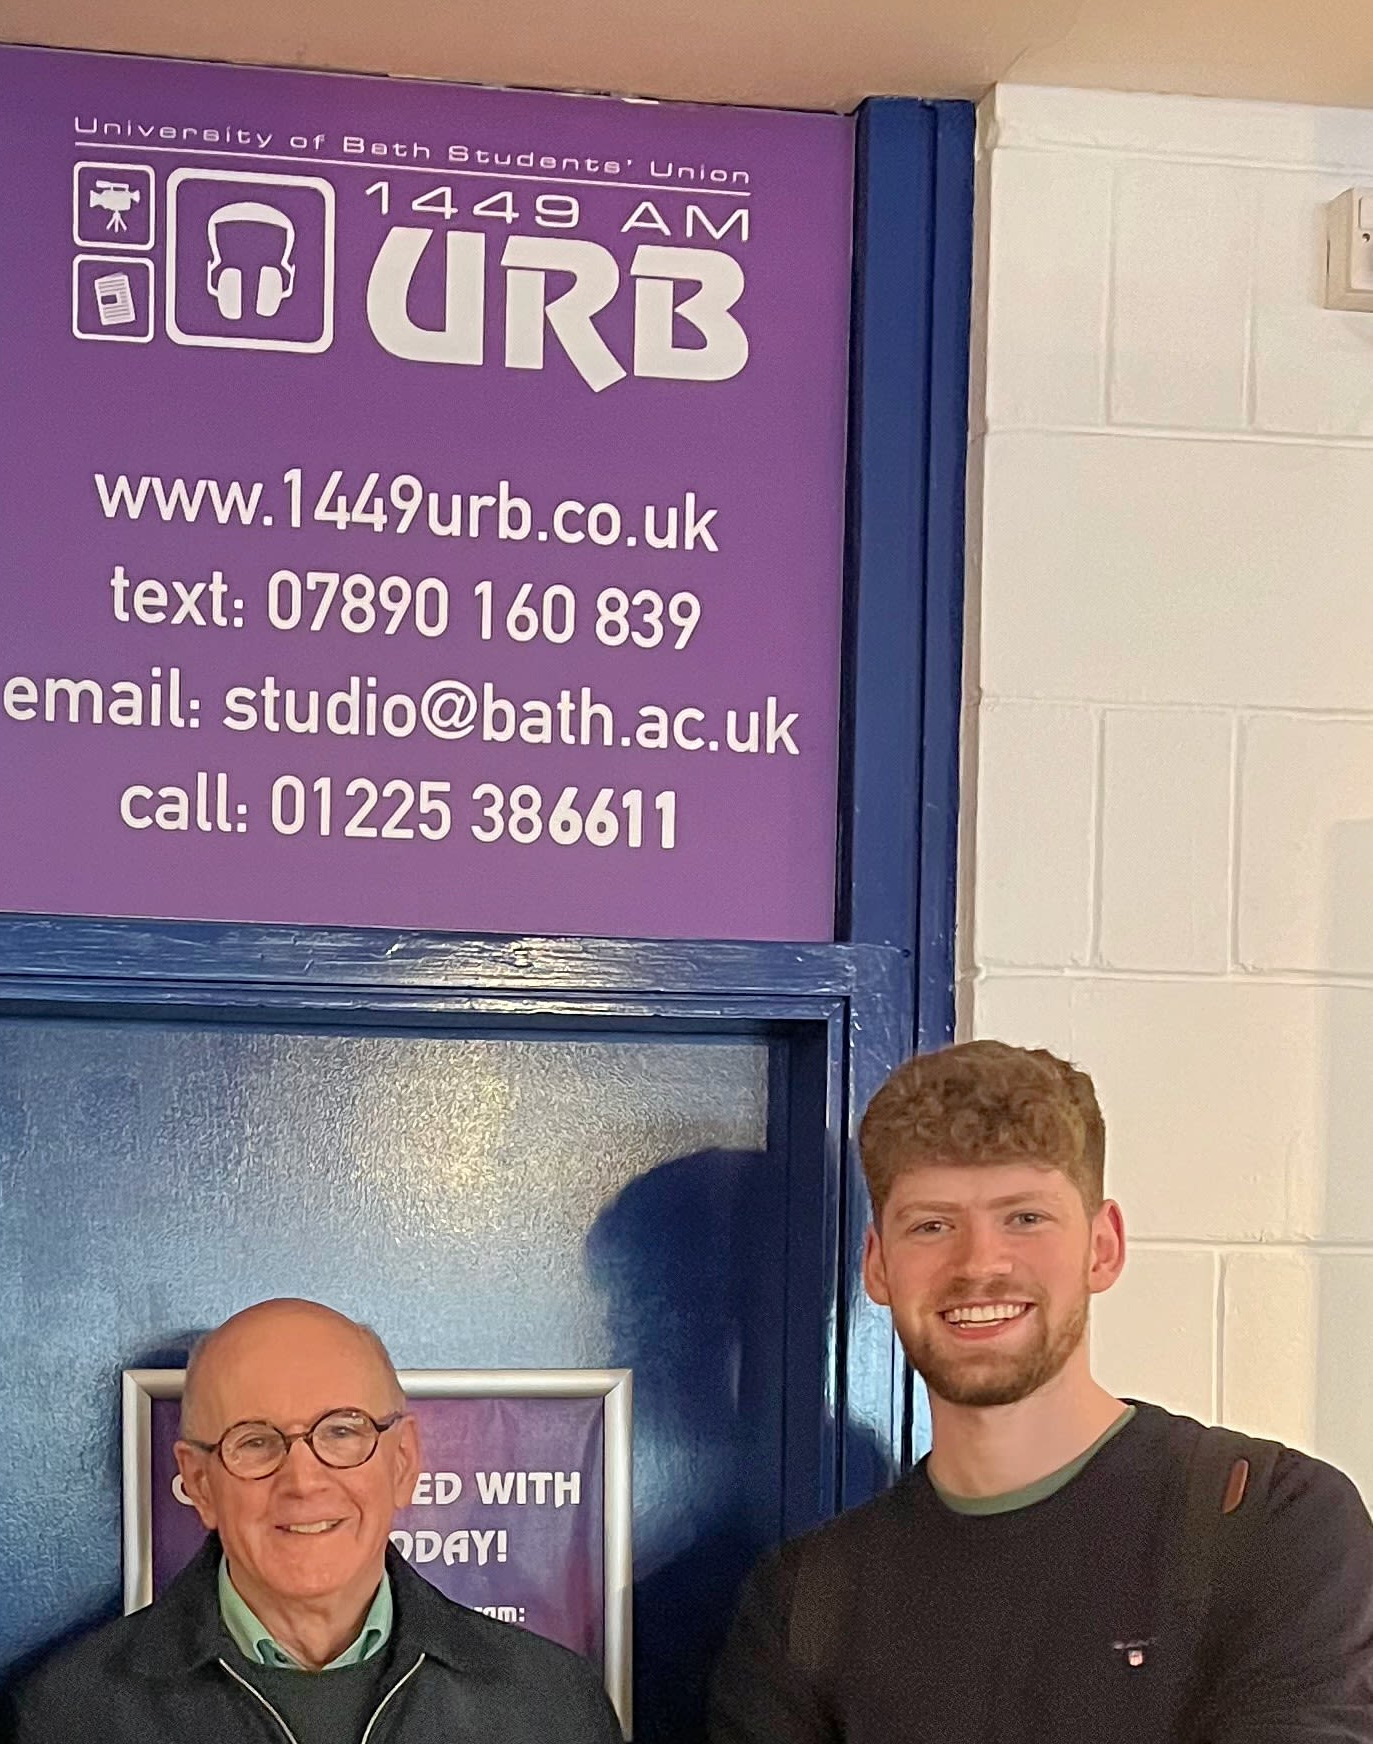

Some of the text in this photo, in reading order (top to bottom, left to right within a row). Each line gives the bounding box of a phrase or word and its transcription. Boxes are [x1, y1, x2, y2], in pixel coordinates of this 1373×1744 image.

[74, 116, 273, 150] University
[289, 134, 326, 150] of
[343, 136, 430, 160] Bath
[649, 160, 750, 185] Union
[365, 181, 750, 242] 1449 AM
[365, 226, 750, 394] URB
[94, 468, 719, 552] www.1449urb.co.uk
[110, 565, 701, 650] text: 07890 160 839
[3, 666, 800, 755] email: studio@bath.ac.uk
[120, 771, 676, 849] call: 01225 386611
[475, 1471, 581, 1507] WITH
